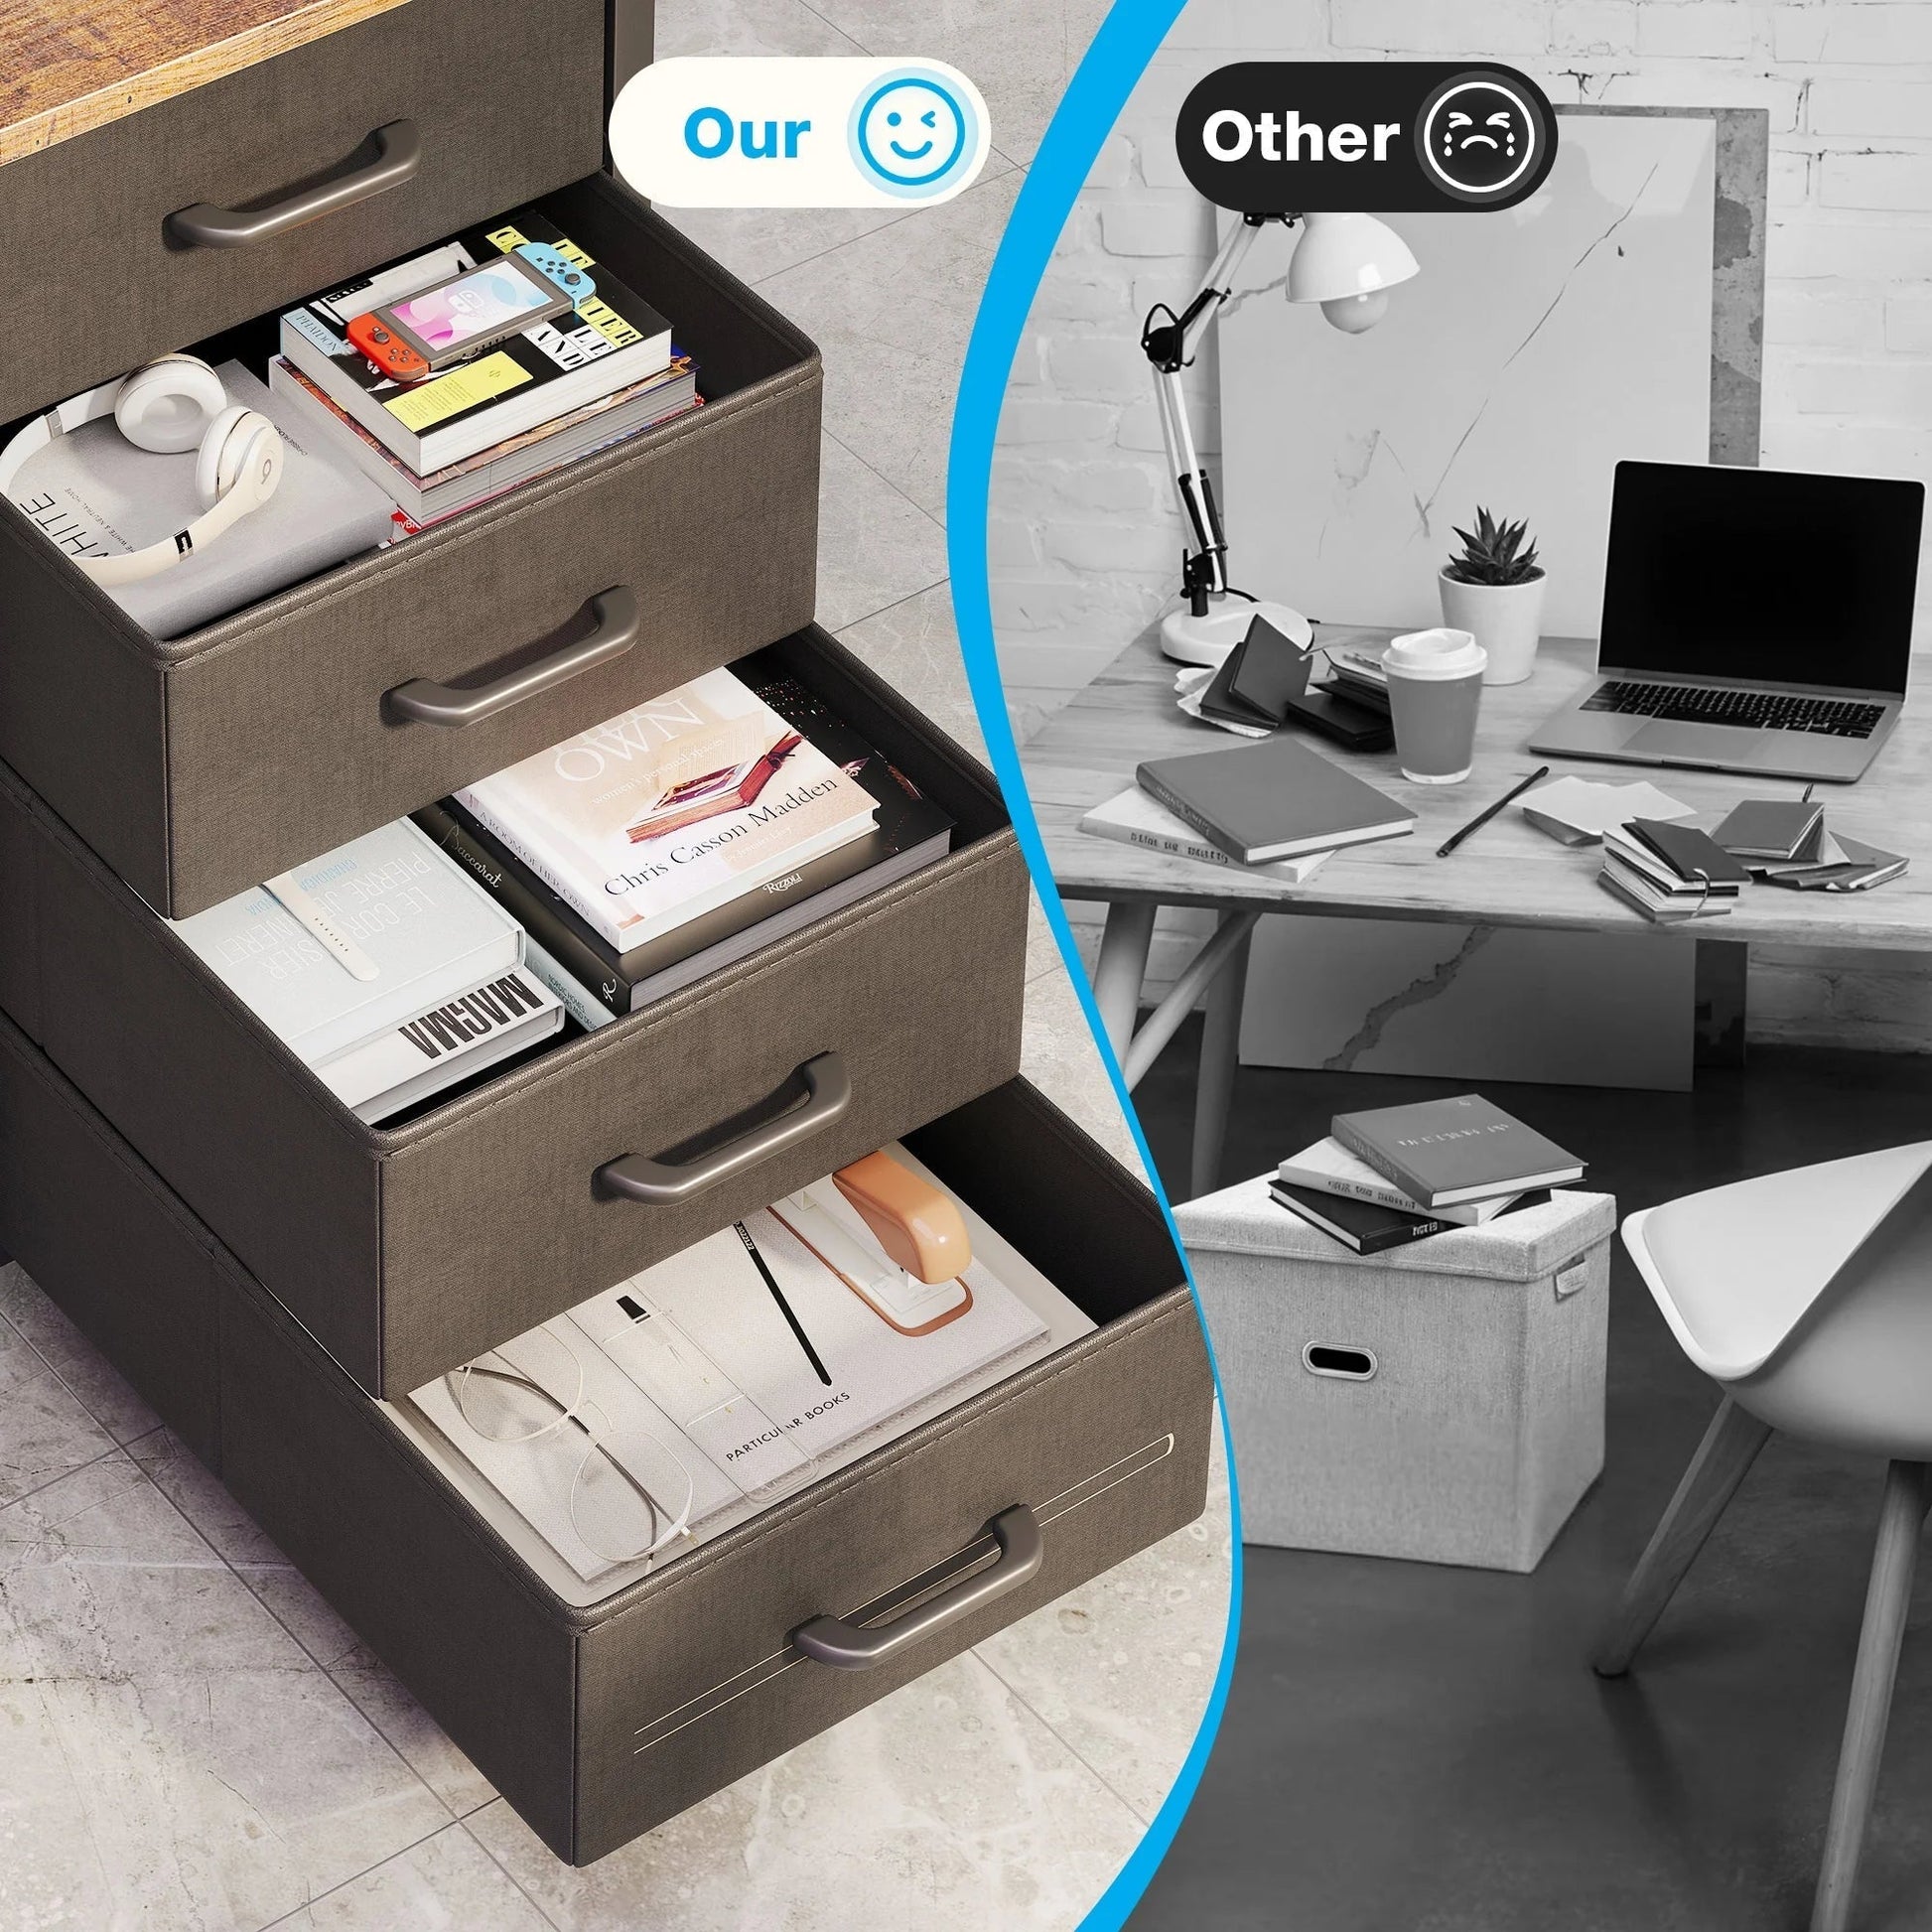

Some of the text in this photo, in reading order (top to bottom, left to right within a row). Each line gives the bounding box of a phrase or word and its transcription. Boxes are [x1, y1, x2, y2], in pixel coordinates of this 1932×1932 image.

[555, 698, 704, 783] OWN
[439, 810, 503, 889] Baccarat
[604, 777, 839, 896] Chris Casson Madden
[344, 851, 433, 905] PIERRE
[397, 973, 544, 1059] MAGMA
[804, 1391, 851, 1421] BOOKS
